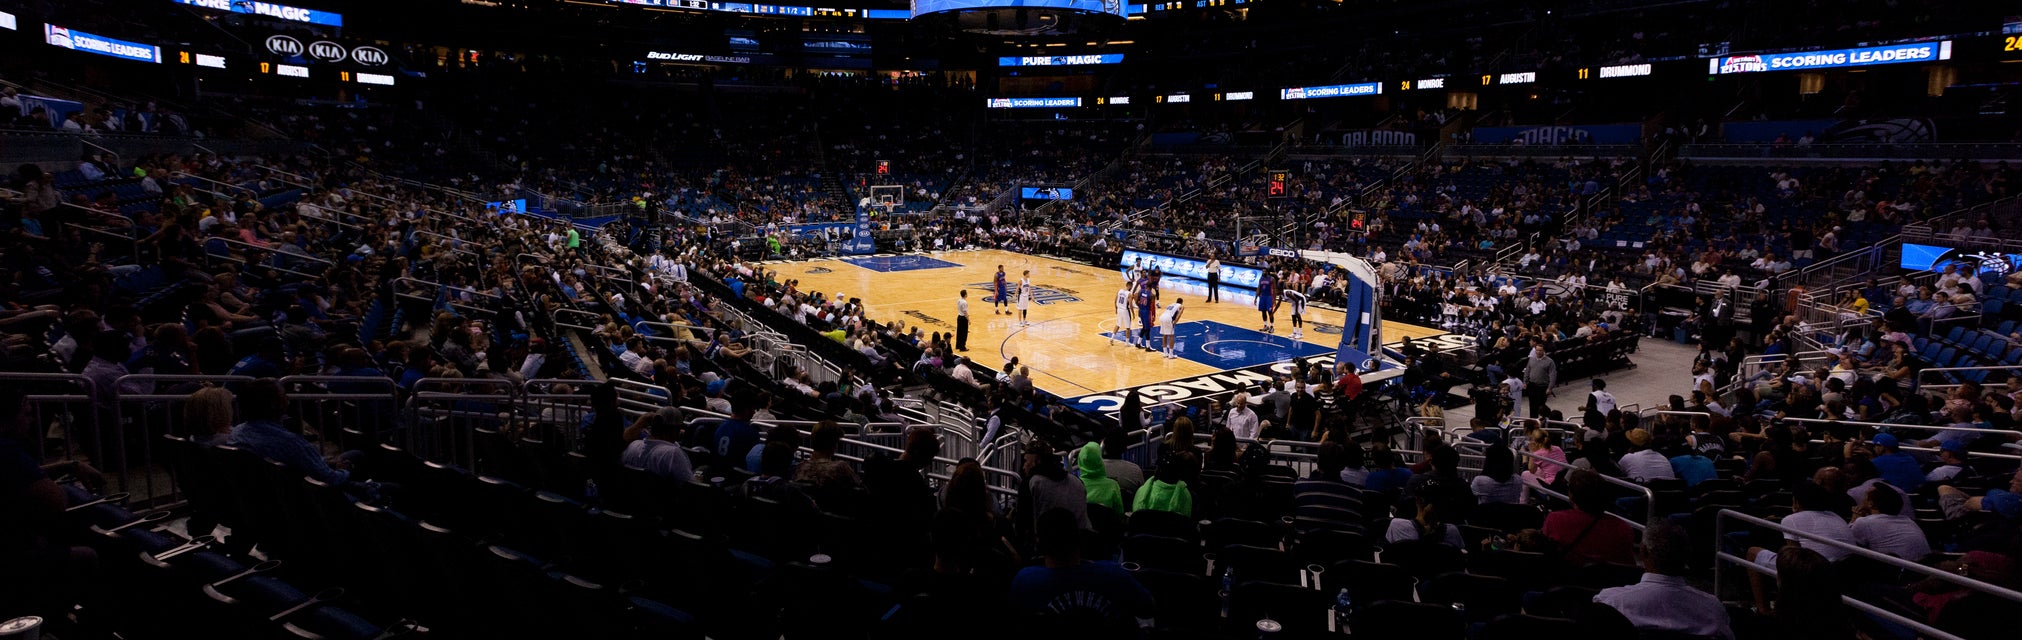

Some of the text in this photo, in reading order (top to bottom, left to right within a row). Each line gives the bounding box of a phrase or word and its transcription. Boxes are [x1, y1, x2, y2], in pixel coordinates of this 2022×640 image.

[254, 1, 311, 22] MAGIC
[74, 35, 111, 53] SCORING
[112, 42, 152, 59] LEADERS
[273, 39, 298, 53] KIA
[2004, 36, 2022, 51] 24
[316, 45, 340, 58] KIA
[358, 49, 382, 62] KIA
[671, 53, 704, 61] LIGHT
[1022, 55, 1102, 65] PURE MAGIC
[1720, 46, 1931, 74] PISTONS SCORING LEADERS
[260, 62, 269, 73] 17
[1578, 64, 1651, 79] 11 DRUMMOND
[341, 71, 349, 82] 11
[1482, 72, 1536, 85] 17 AUGUSTIN
[1401, 79, 1444, 90] 24 MONROE
[1214, 93, 1220, 101] 11
[1307, 88, 1339, 97] SCORING
[1340, 85, 1374, 94] LEADERS
[1097, 97, 1104, 105] 24
[1167, 95, 1190, 103] AUGUSTIN
[1270, 181, 1284, 195] 24
[1351, 219, 1362, 228] 24
[1269, 248, 1295, 258] GEICO
[1606, 293, 1629, 303] PURE
[717, 436, 730, 457] 8
